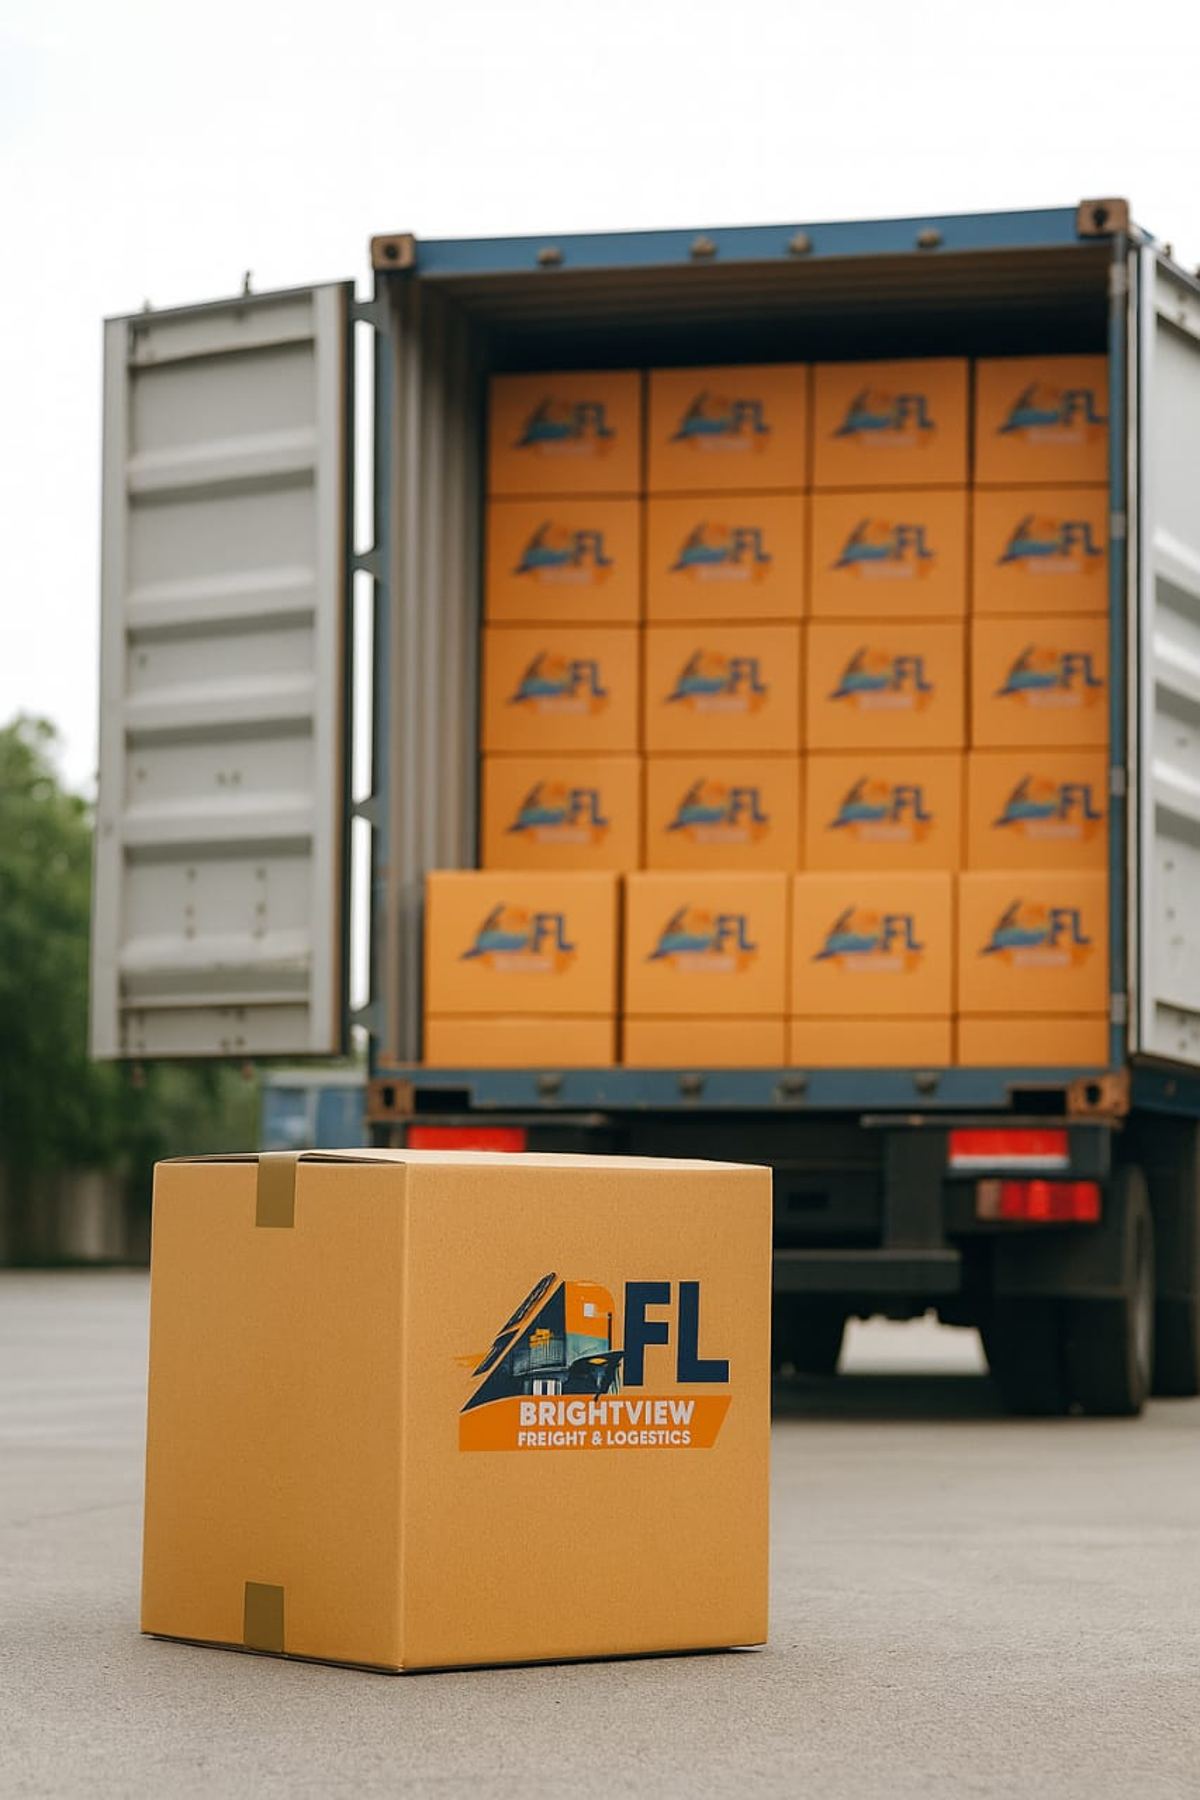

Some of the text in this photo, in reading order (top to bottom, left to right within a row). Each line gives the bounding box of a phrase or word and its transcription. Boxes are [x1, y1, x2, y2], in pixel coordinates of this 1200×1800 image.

[519, 1400, 695, 1426] BRIGHTVIEW
[517, 1430, 691, 1446] FREIGHT & LOGESTICS
